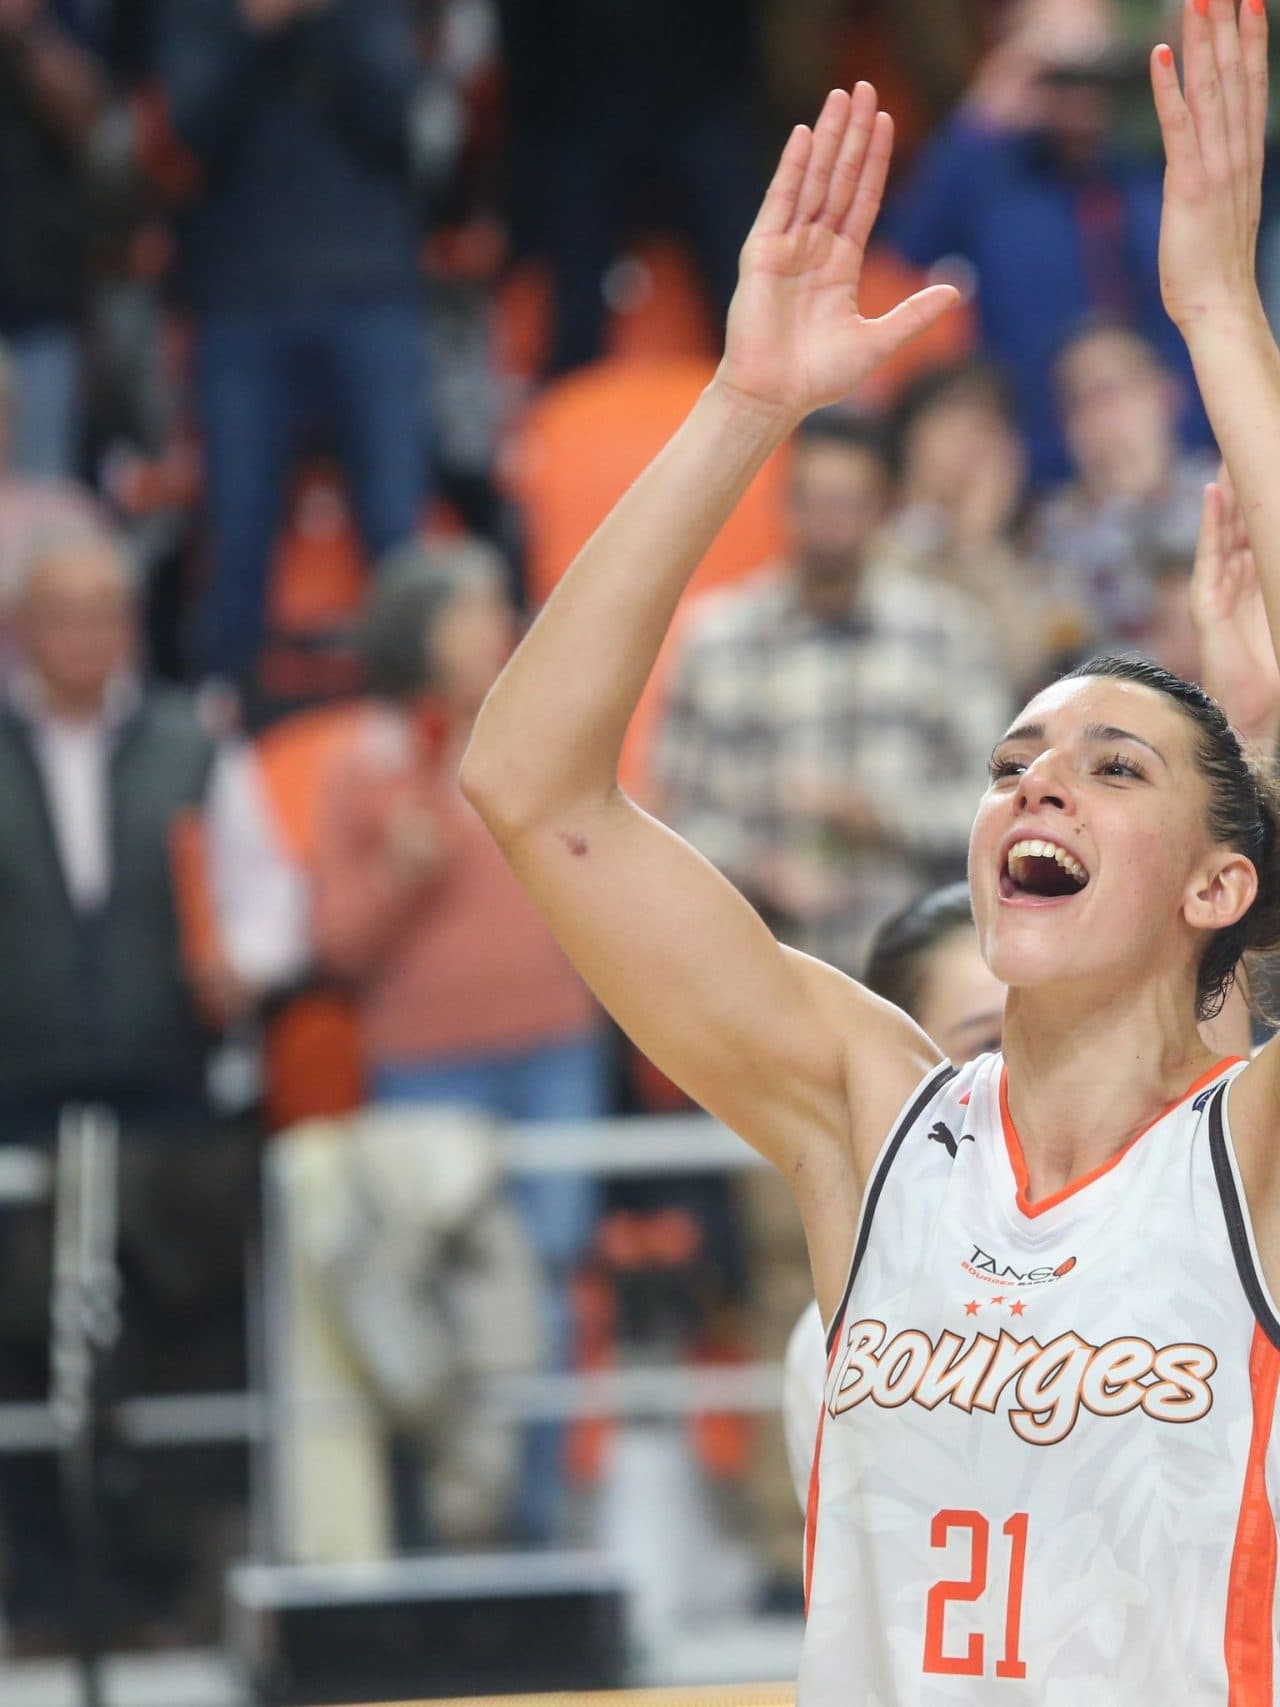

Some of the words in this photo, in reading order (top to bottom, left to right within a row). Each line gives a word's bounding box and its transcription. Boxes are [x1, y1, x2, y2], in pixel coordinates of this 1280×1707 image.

[969, 1243, 1078, 1282] TANGO
[825, 1318, 1218, 1446] Bourges
[922, 1508, 1030, 1679] 21
